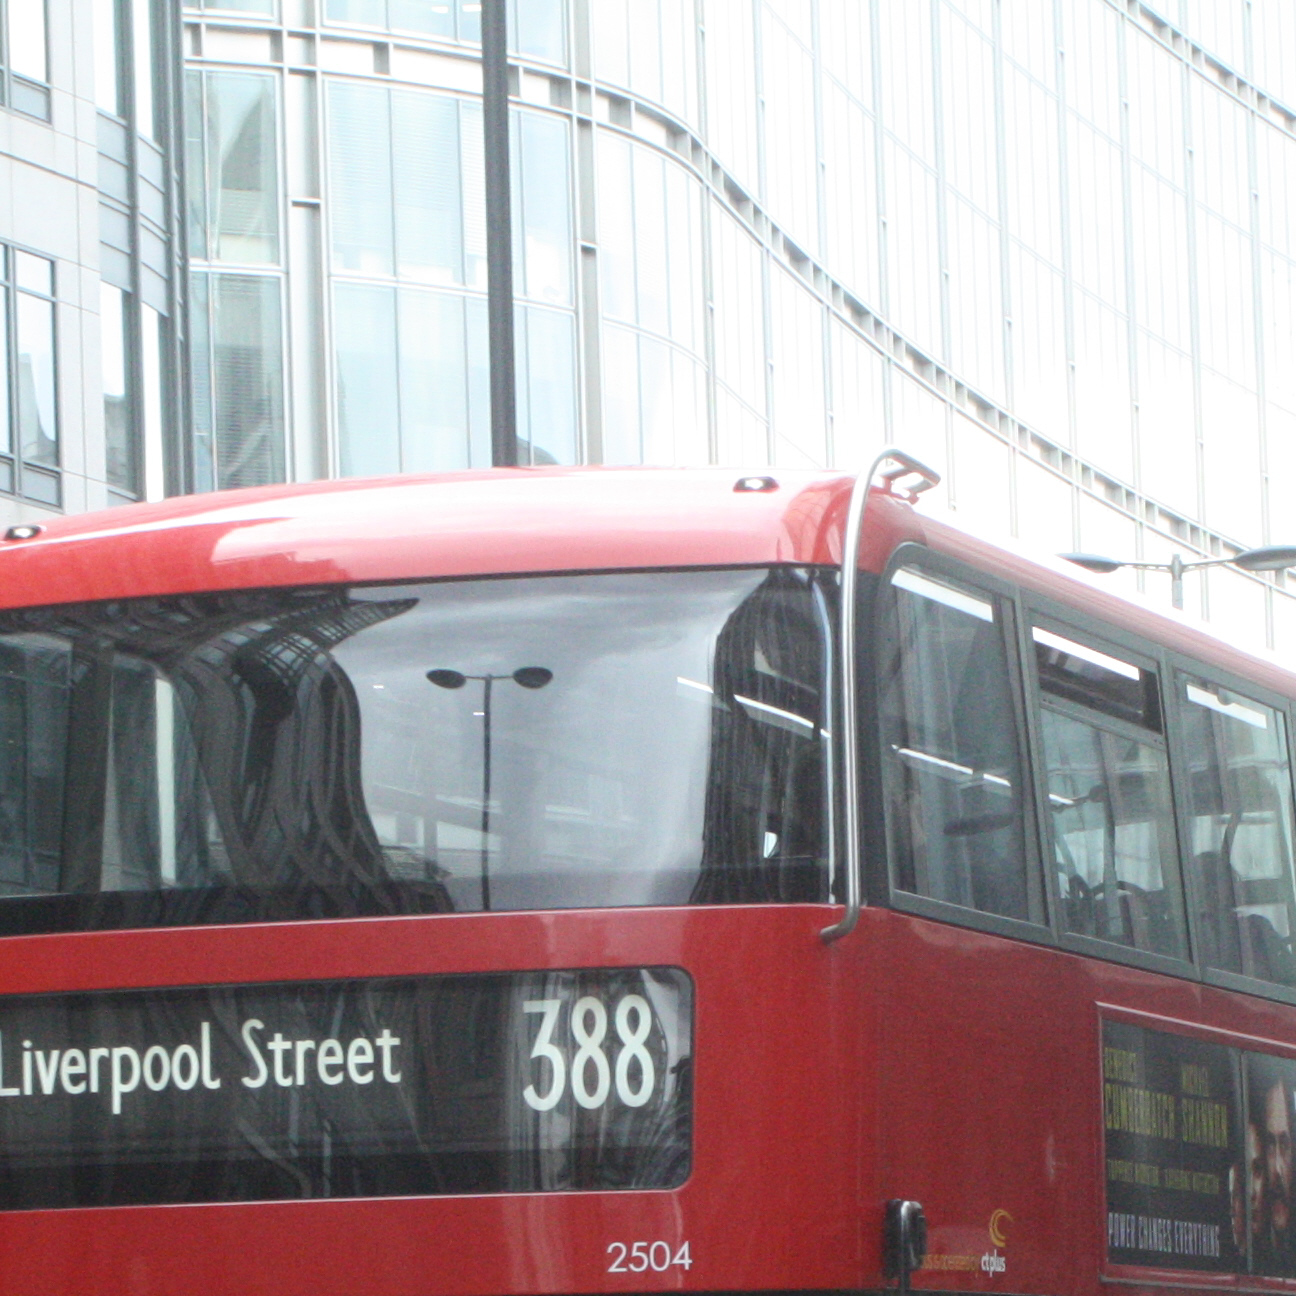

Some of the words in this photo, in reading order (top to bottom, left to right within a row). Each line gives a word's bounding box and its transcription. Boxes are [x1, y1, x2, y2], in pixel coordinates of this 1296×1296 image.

[241, 1018, 401, 1090] Street
[522, 994, 656, 1112] 388
[607, 1241, 693, 1273] 2504
[1108, 1212, 1135, 1248] POWER
